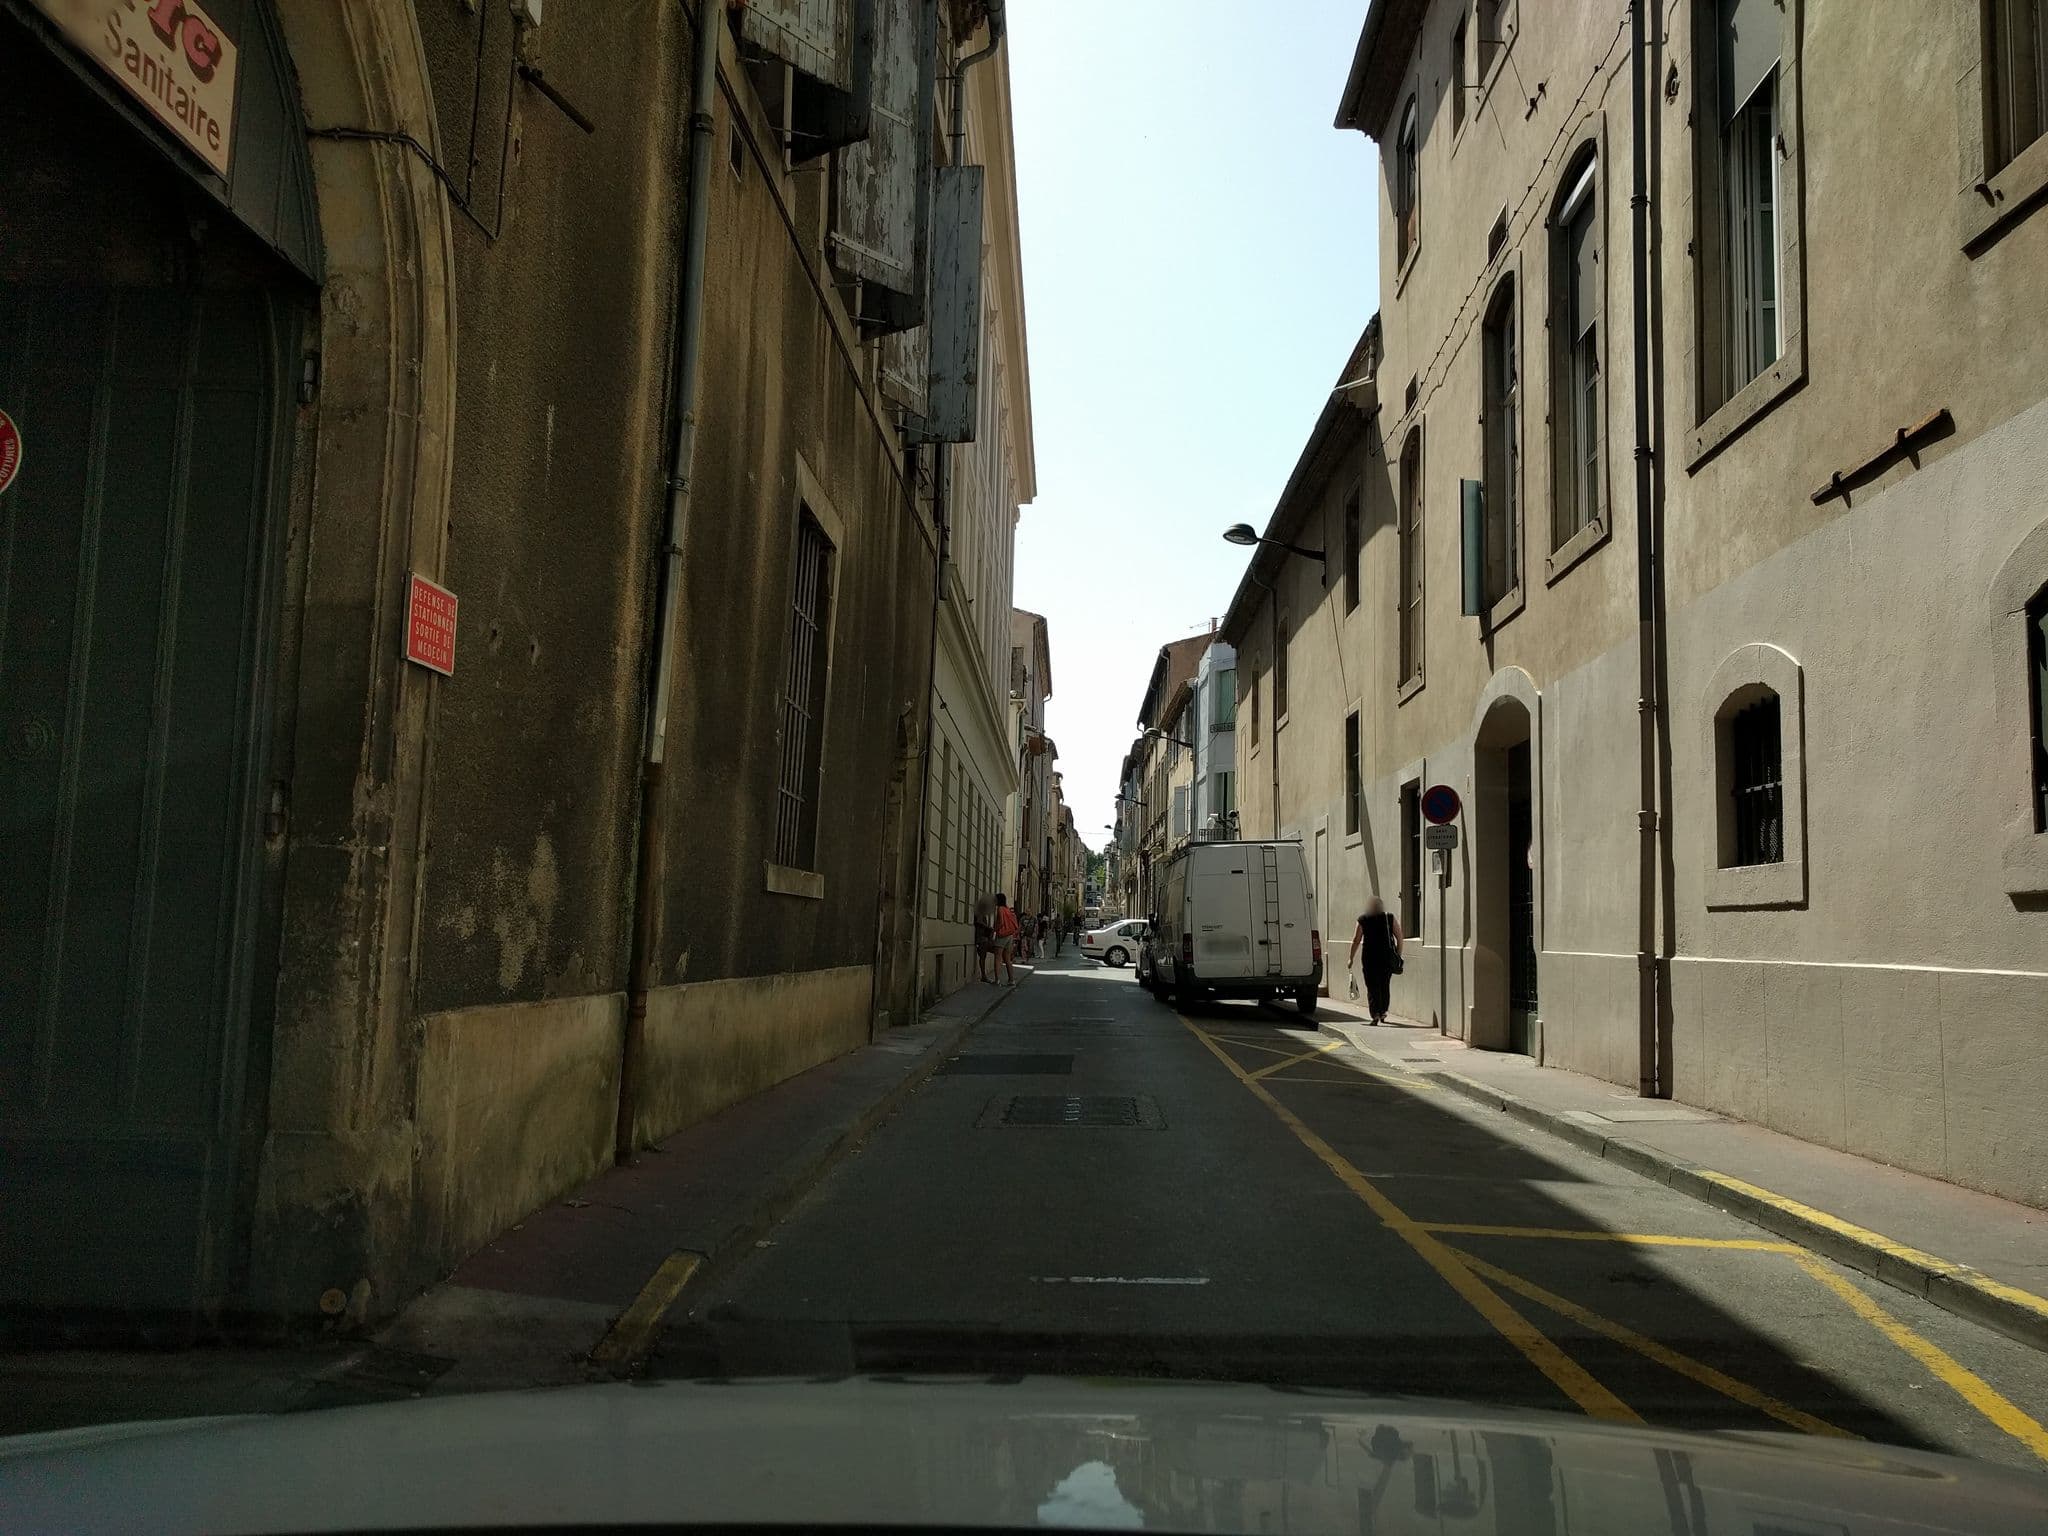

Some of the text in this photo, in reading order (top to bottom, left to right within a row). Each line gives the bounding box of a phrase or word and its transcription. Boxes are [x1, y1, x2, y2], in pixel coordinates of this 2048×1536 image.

[104, 9, 221, 151] Sanitaire
[414, 586, 455, 618] DEFENSE DE
[414, 603, 454, 634] STATIONNER
[416, 622, 451, 649] SORTIE DE
[417, 640, 447, 664] MEDECIN
